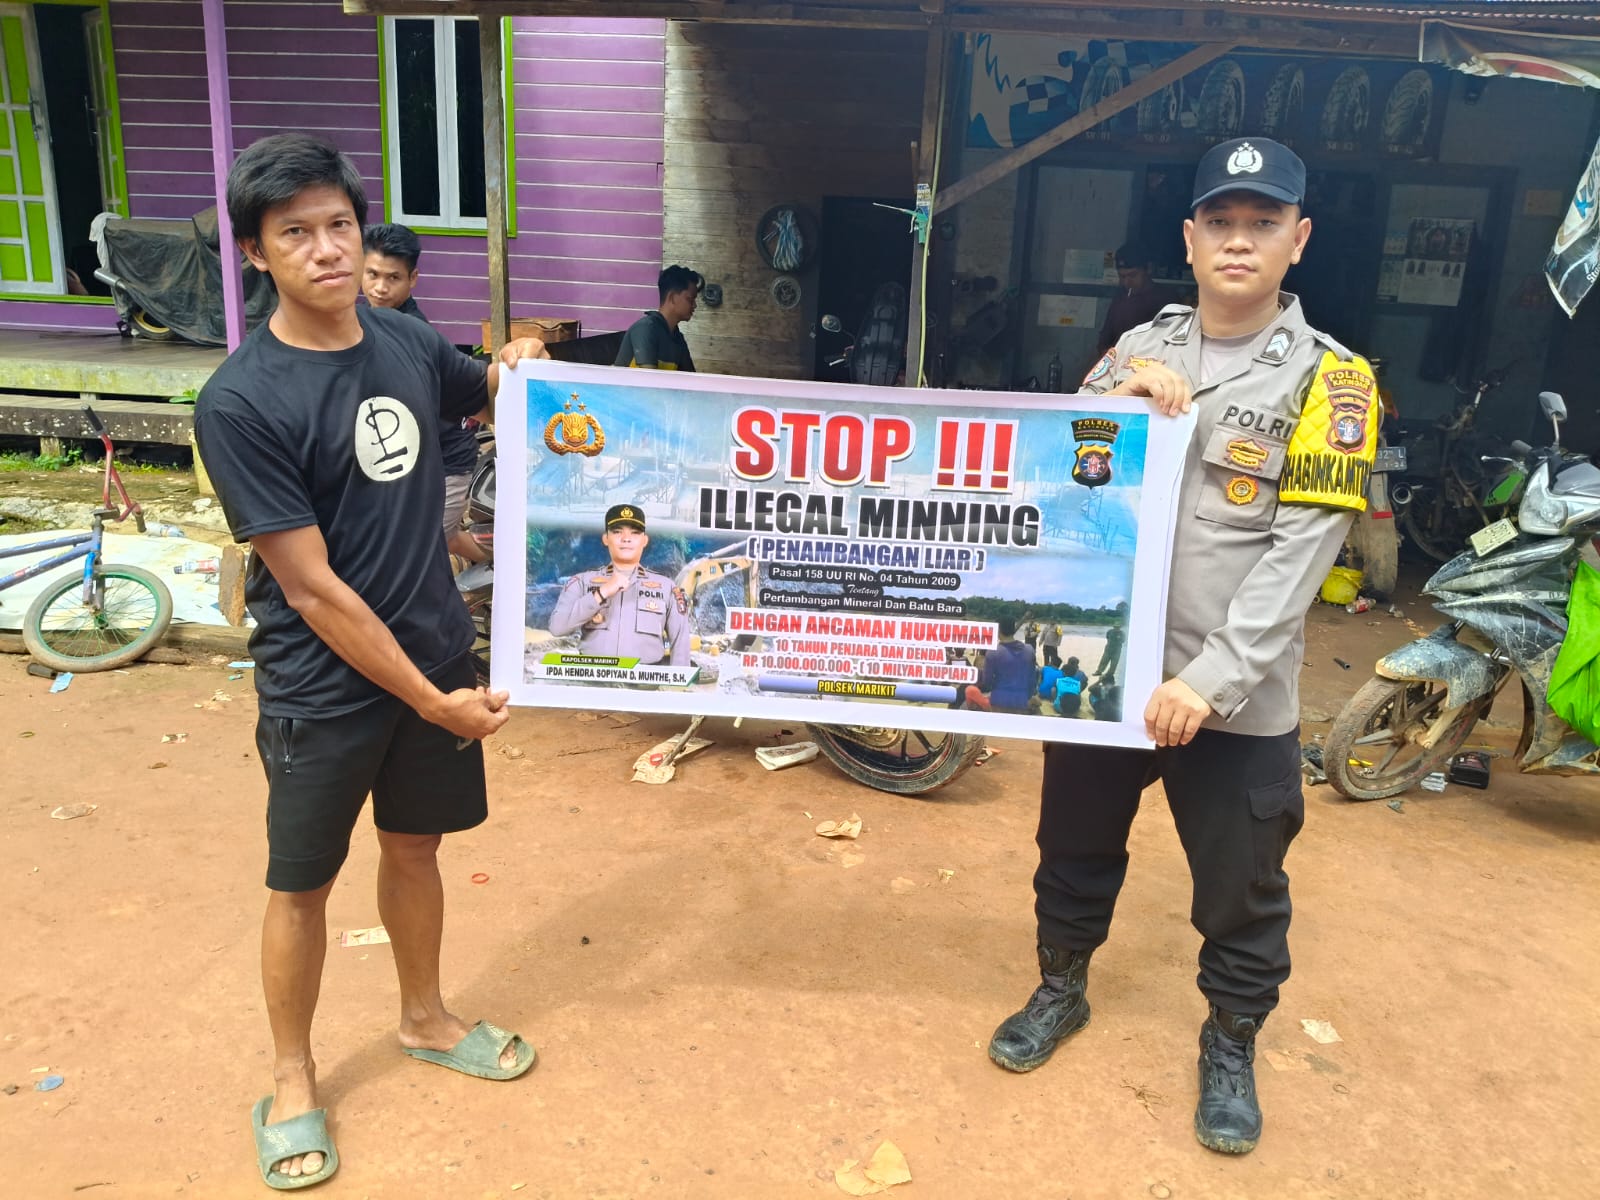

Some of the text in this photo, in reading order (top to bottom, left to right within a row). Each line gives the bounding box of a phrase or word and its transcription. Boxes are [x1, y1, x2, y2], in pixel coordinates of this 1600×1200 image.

[1327, 370, 1370, 387] POLRES
[1077, 419, 1115, 428] POLRES
[1223, 405, 1293, 439] POLRI
[732, 406, 1015, 491] STOP !!!
[699, 487, 1040, 547] ILLEGAL MINNING
[924, 547, 971, 571] LIAR
[772, 567, 957, 586] Pasal 158 UU RI No. 04 Tahun 2009
[638, 590, 664, 599] POLRI
[847, 584, 879, 597] Tentang
[764, 592, 962, 613] Pertambangan Mineral Dan Batu Bara
[730, 611, 994, 645] DENGAN ANCAMAN HUKUMAN
[562, 656, 592, 664] KAPOLSEK
[776, 639, 944, 662] 10 TAHUN PENJARA DAN DENDA
[546, 666, 687, 683] IPDA HENDRA SOPIYAN D. MUNTHE, S.H.
[742, 654, 758, 667] RP.
[867, 661, 880, 675] 10
[882, 662, 923, 678] MILYAR
[925, 665, 968, 680] RUPIAH
[818, 680, 896, 697] POLSEK MARIKIT
